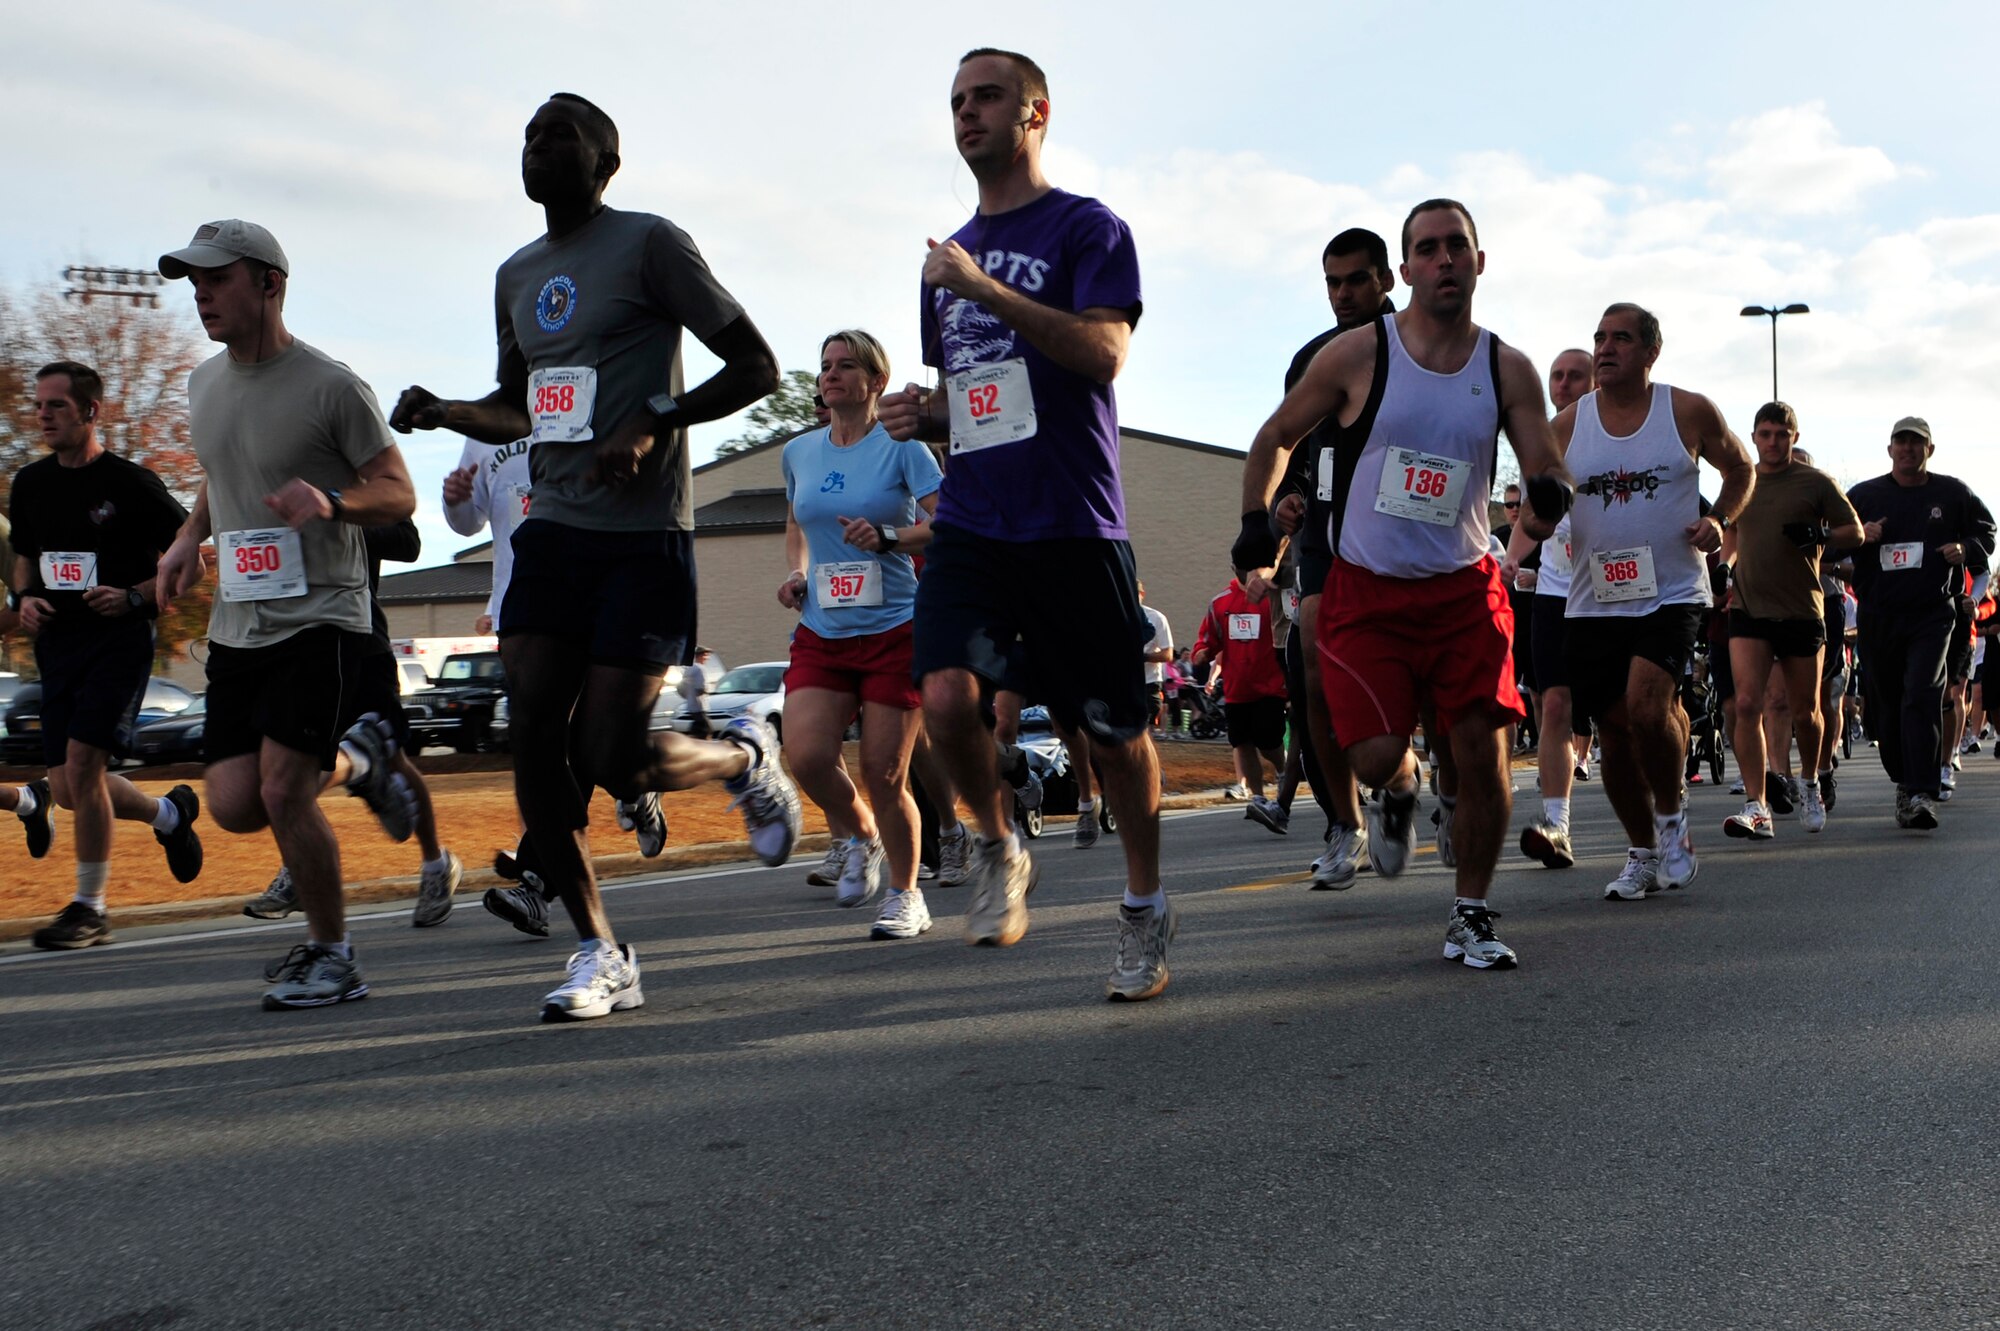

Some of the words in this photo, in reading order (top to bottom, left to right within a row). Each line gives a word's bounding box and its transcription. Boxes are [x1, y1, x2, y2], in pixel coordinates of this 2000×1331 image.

[537, 275, 576, 303] PENSACOLA
[536, 308, 566, 331] MARATHON
[534, 385, 575, 414] 358
[968, 383, 1002, 417] 52
[1404, 466, 1448, 498] 136
[1585, 476, 1660, 497] AFSOC
[235, 545, 281, 574] 350
[1892, 551, 1907, 565] 21
[52, 563, 82, 582] 145
[1603, 560, 1639, 582] 368
[830, 574, 865, 597] 357
[1237, 620, 1251, 630] 151
